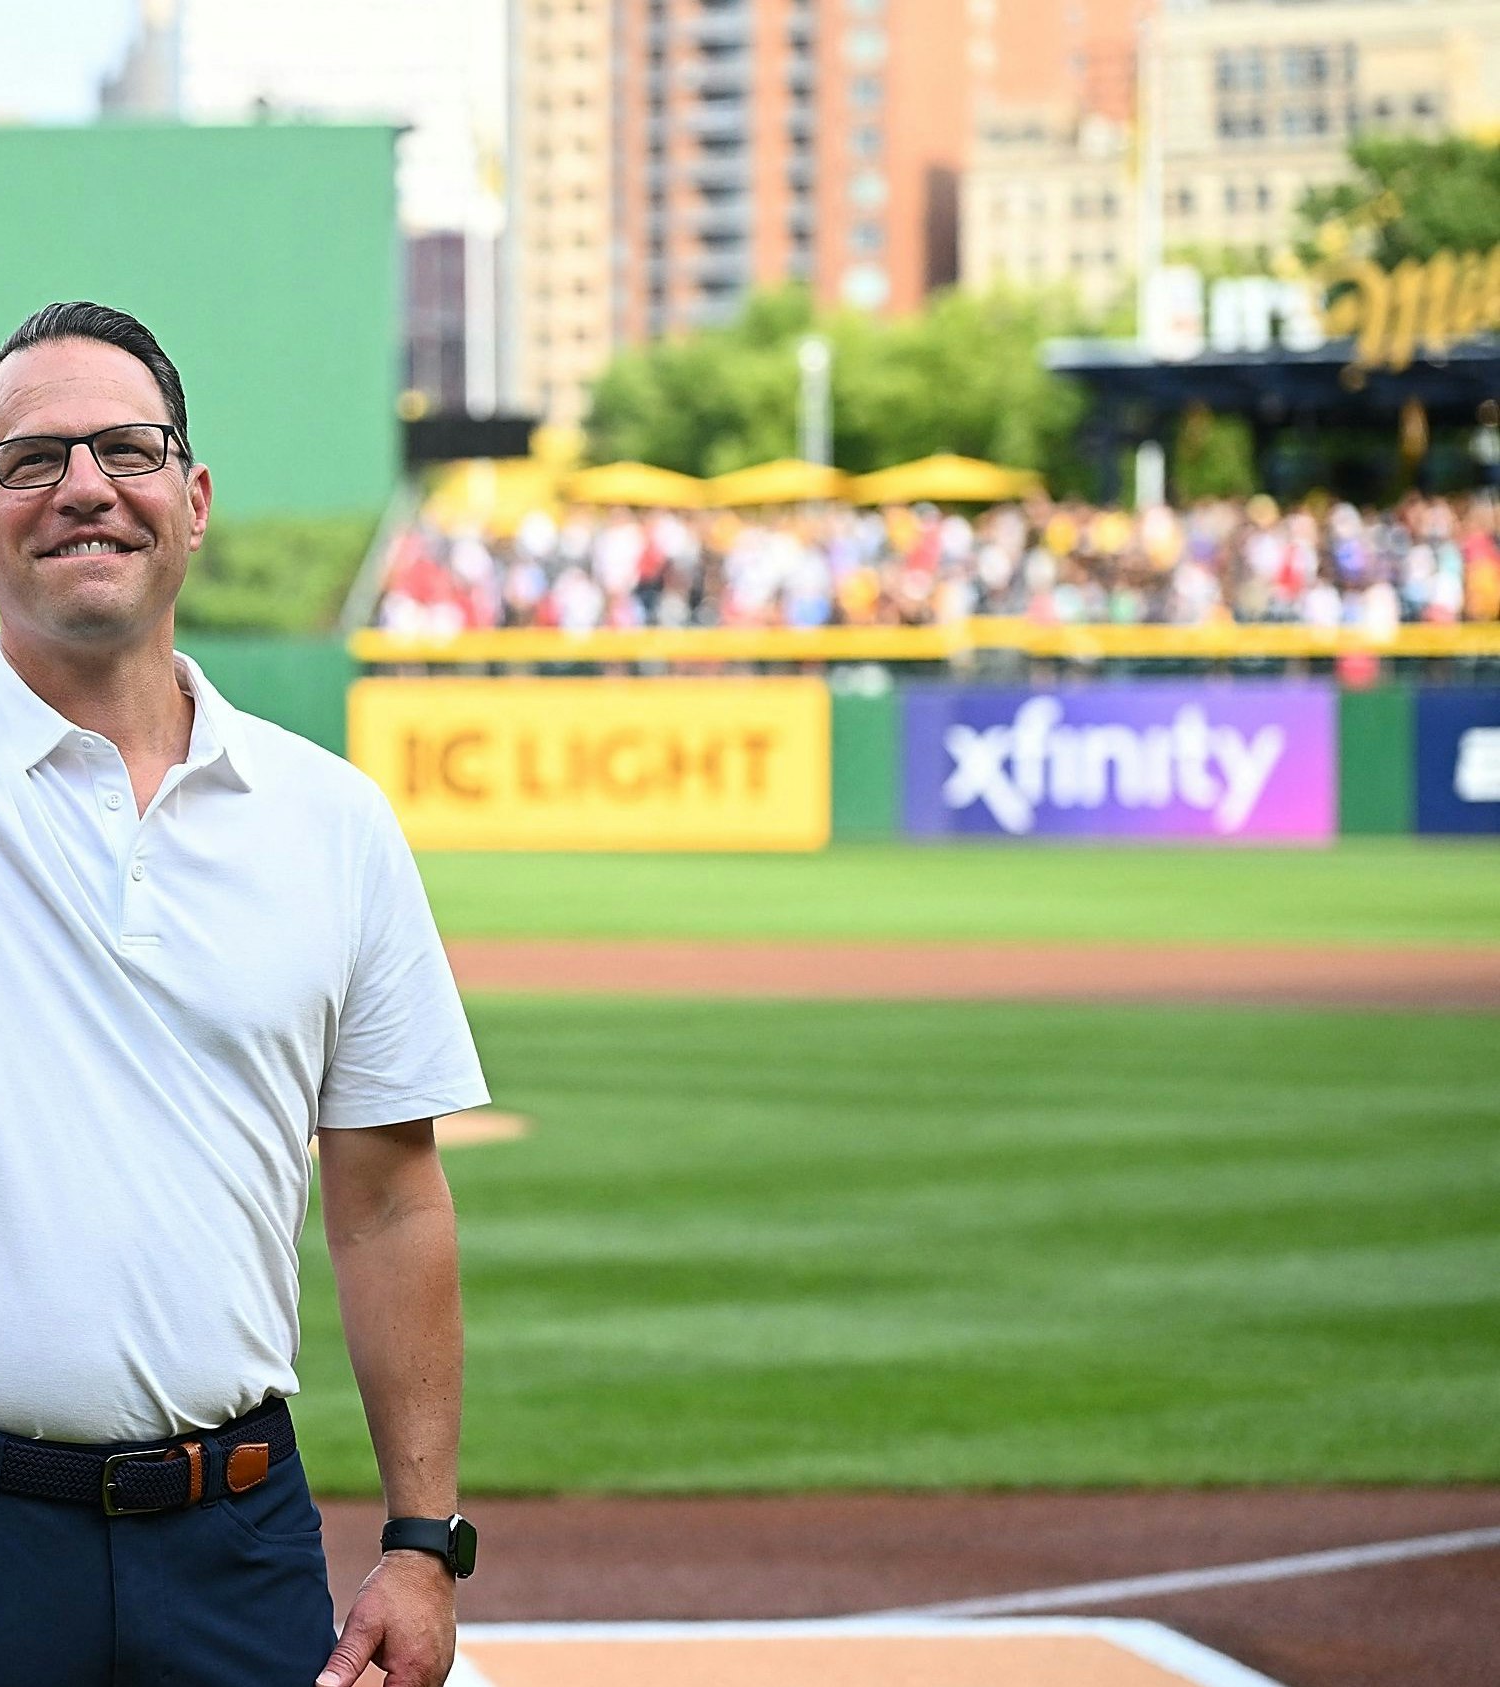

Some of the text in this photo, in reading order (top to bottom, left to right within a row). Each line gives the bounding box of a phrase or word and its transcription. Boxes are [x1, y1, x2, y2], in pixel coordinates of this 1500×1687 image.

[401, 728, 777, 802] IC LIGHT
[943, 695, 1285, 834] xfinity
